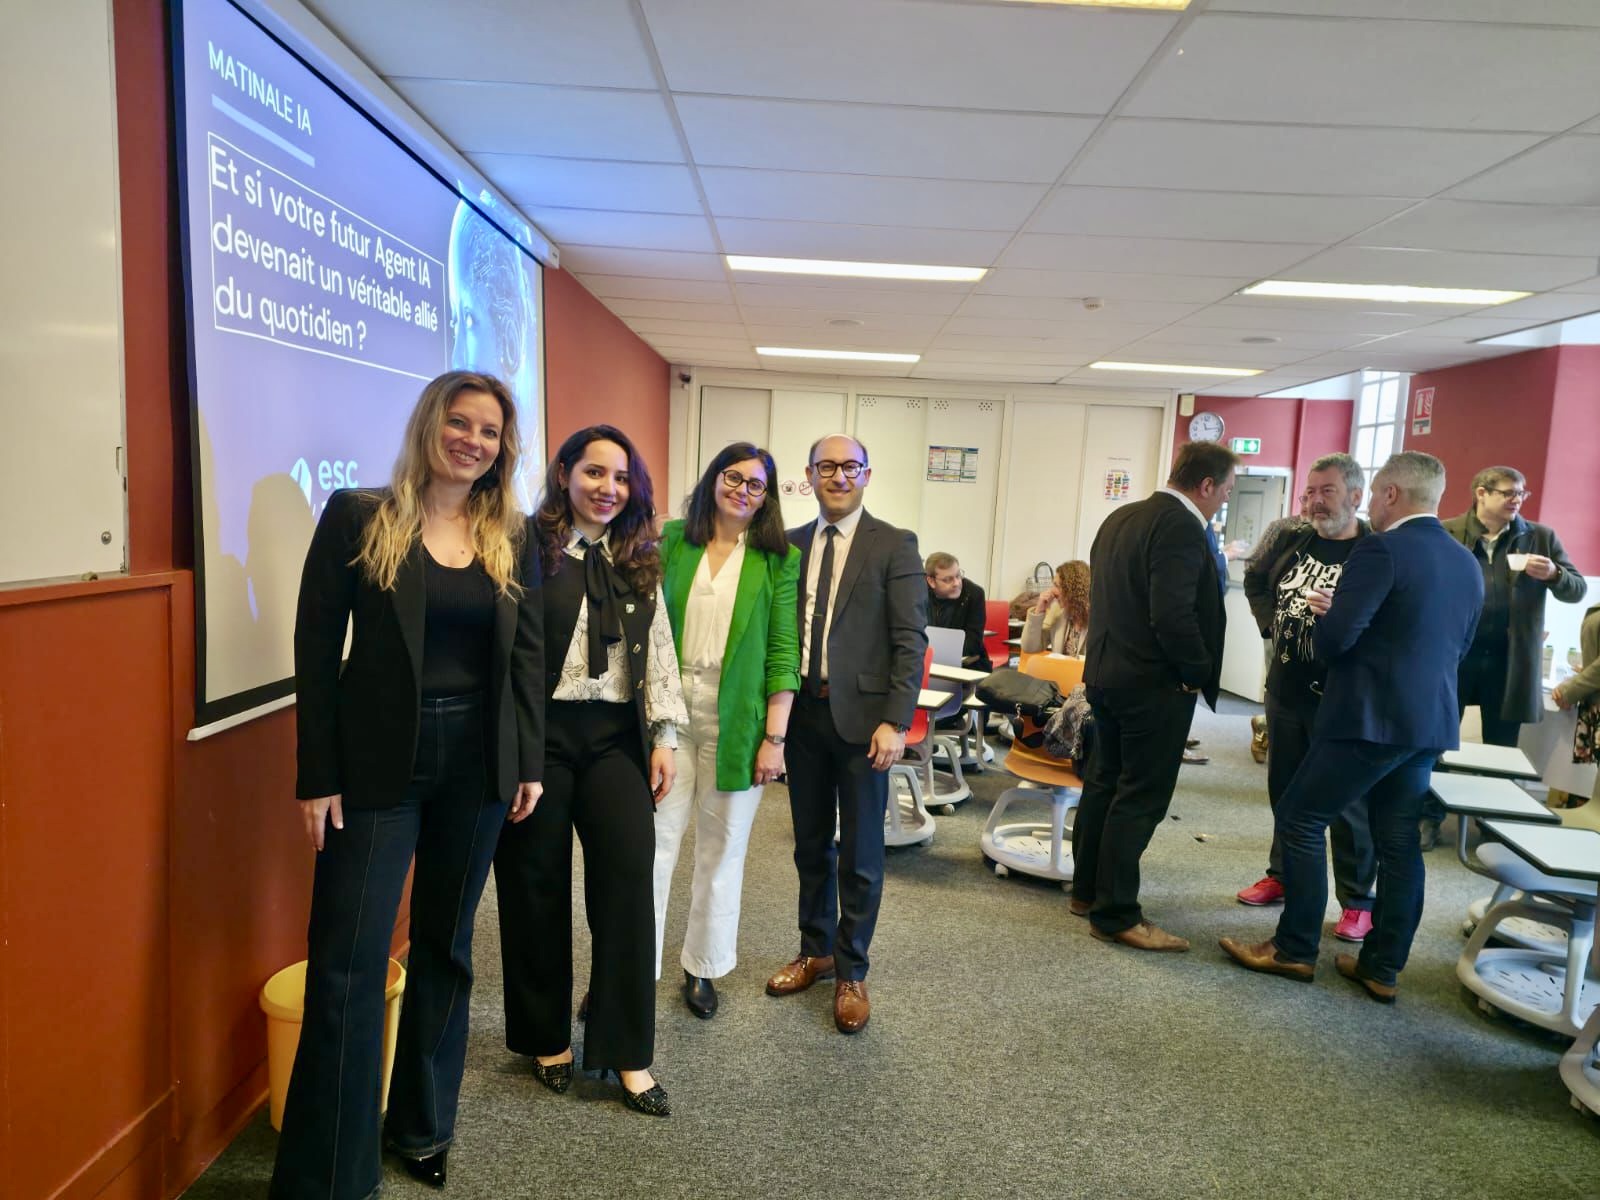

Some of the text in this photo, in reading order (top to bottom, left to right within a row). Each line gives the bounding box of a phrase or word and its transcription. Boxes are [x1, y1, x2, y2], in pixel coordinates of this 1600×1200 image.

[208, 40, 312, 136] MATINALE IA
[211, 144, 431, 289] Et si votre futur Agent IA
[213, 213, 438, 332] devenait un véritable allié
[215, 276, 367, 351] du quotidien ?
[318, 459, 359, 491] esc
